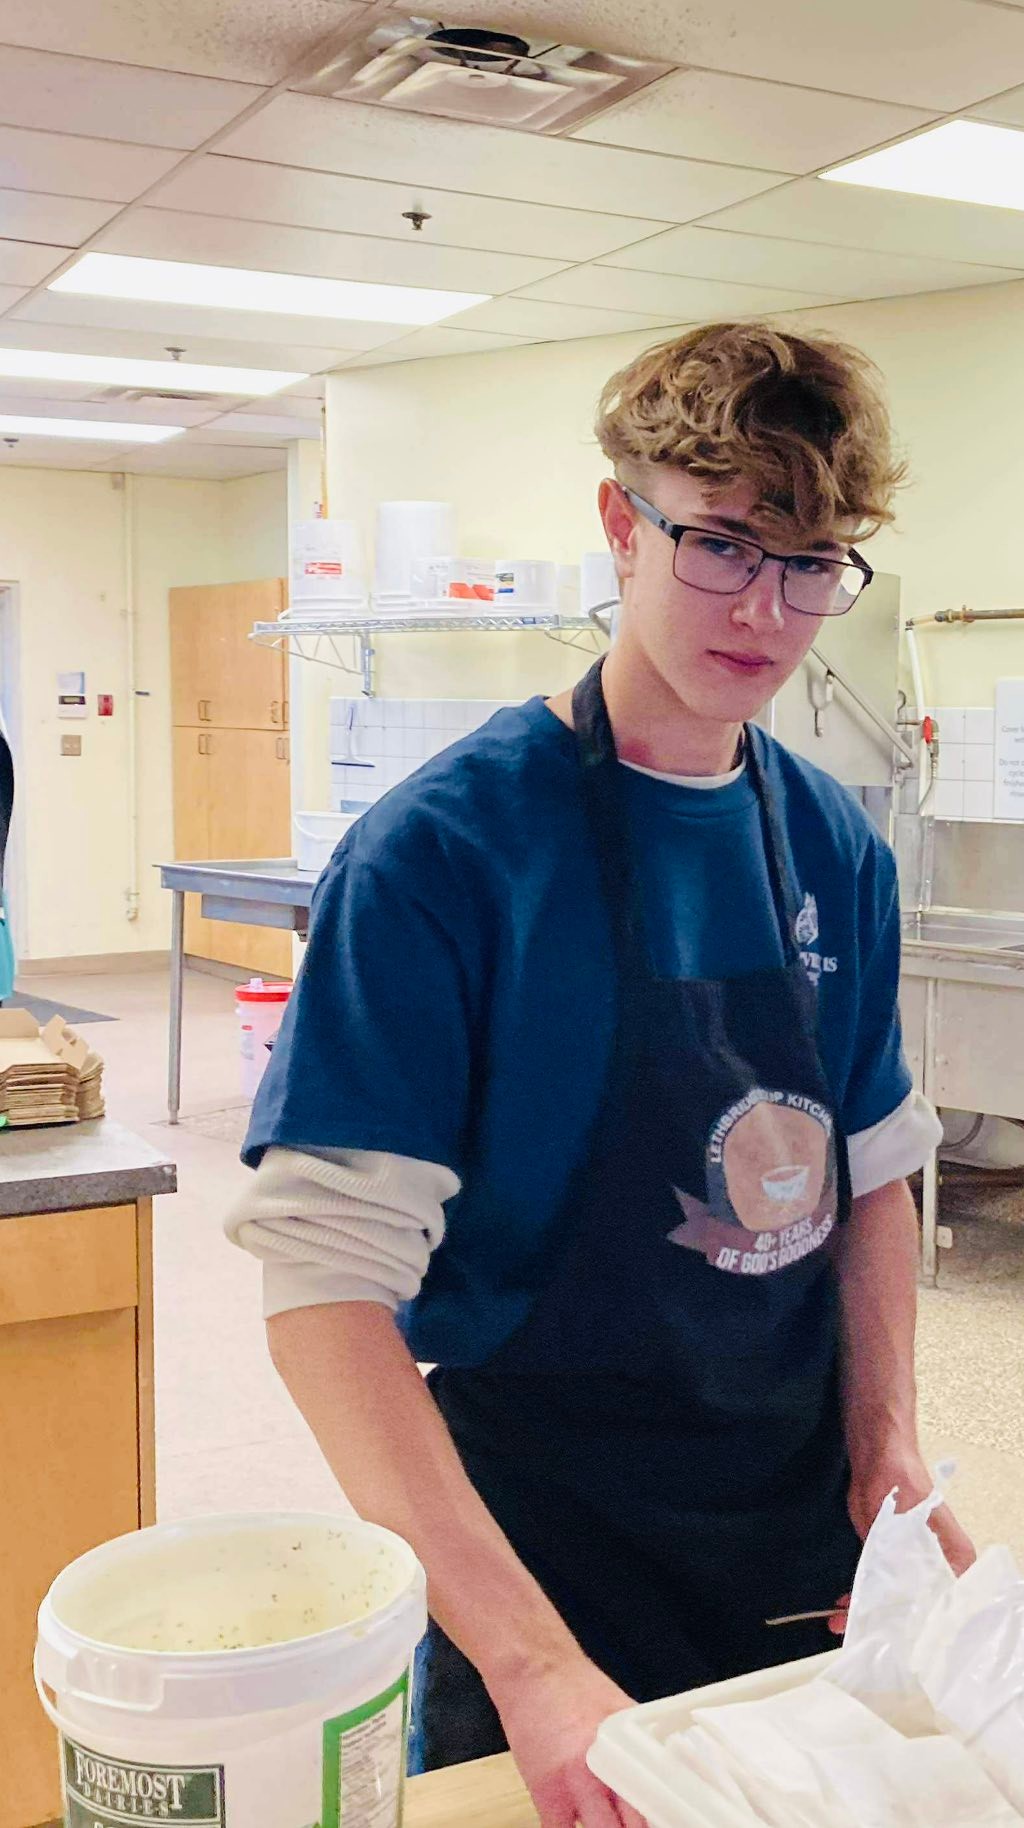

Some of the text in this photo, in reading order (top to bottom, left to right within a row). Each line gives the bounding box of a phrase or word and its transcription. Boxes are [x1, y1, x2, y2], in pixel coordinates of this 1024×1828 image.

[999, 758, 1008, 766] Do
[716, 1246, 741, 1271] OF
[740, 1249, 778, 1275] GOD'S
[74, 1749, 186, 1810] FOREMOST
[82, 1781, 169, 1817] DAIRIES
